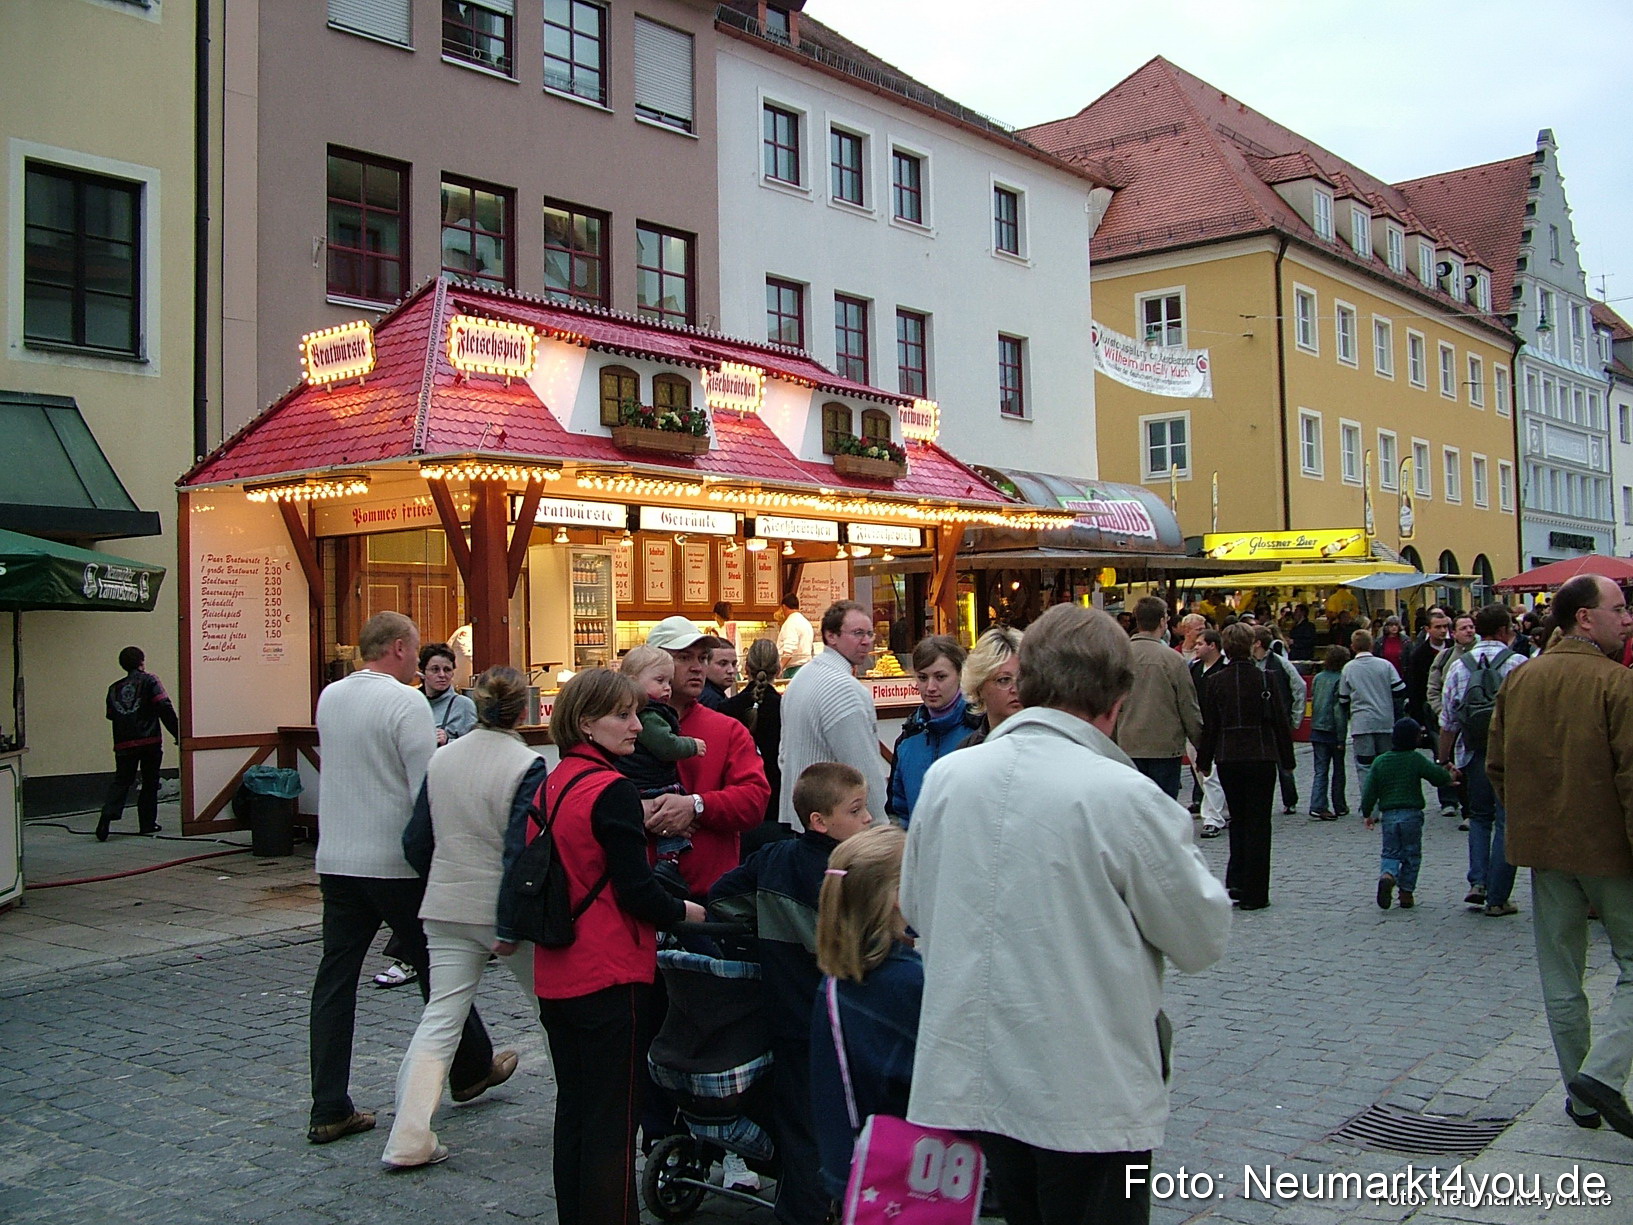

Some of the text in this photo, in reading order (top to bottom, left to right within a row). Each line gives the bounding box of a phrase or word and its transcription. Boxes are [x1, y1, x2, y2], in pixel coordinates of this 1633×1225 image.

[311, 336, 366, 368] Bratwürste
[456, 327, 526, 366] Fleischspieß
[352, 503, 433, 528] Pommes frites
[660, 510, 717, 529] Getränke
[207, 554, 223, 564] Paar
[227, 565, 259, 575] Bratwurst
[264, 566, 282, 575] 2.30
[285, 562, 291, 570] €
[201, 576, 282, 585] Stadtwurst 2.30
[264, 587, 282, 596] 2.30
[201, 597, 282, 608] Frikadelle 2.50
[264, 608, 282, 617] 3.30
[285, 614, 291, 622] €
[201, 619, 282, 630] Currywurst 2.50
[202, 630, 282, 642] Pommes frites 1.50
[907, 1136, 976, 1202] 08
